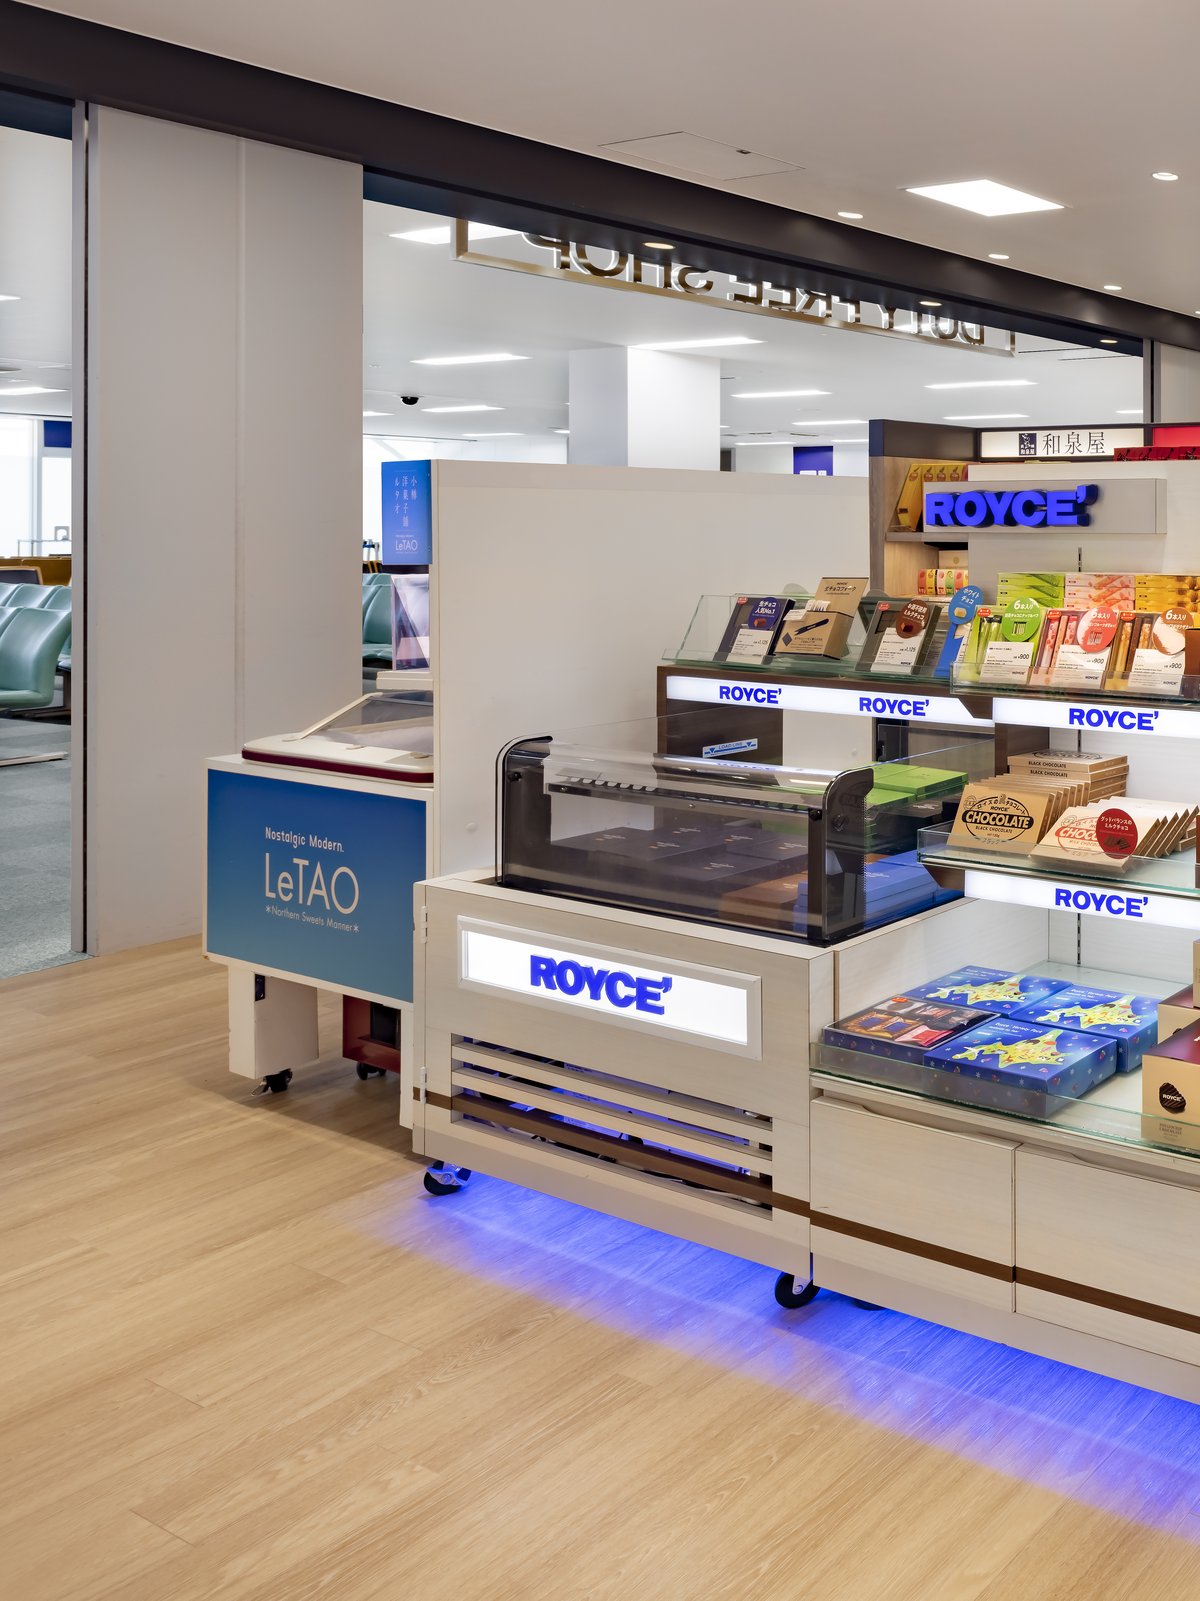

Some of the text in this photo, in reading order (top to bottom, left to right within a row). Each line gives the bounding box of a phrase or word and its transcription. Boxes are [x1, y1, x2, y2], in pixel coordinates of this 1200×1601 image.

[1042, 431, 1105, 455] 和泉屋
[395, 540, 418, 551] LeTAO
[719, 686, 782, 705] ROYCE'
[859, 697, 930, 716] ROYCE'
[1069, 708, 1159, 731] ROYCE'
[965, 811, 1030, 829] CHOCOLATE
[265, 826, 306, 849] Nostalgic
[265, 852, 360, 914] LeTAO
[1055, 888, 1149, 918] ROYCE'
[301, 911, 325, 926] Sweets
[530, 955, 673, 1015] ROYCE'
